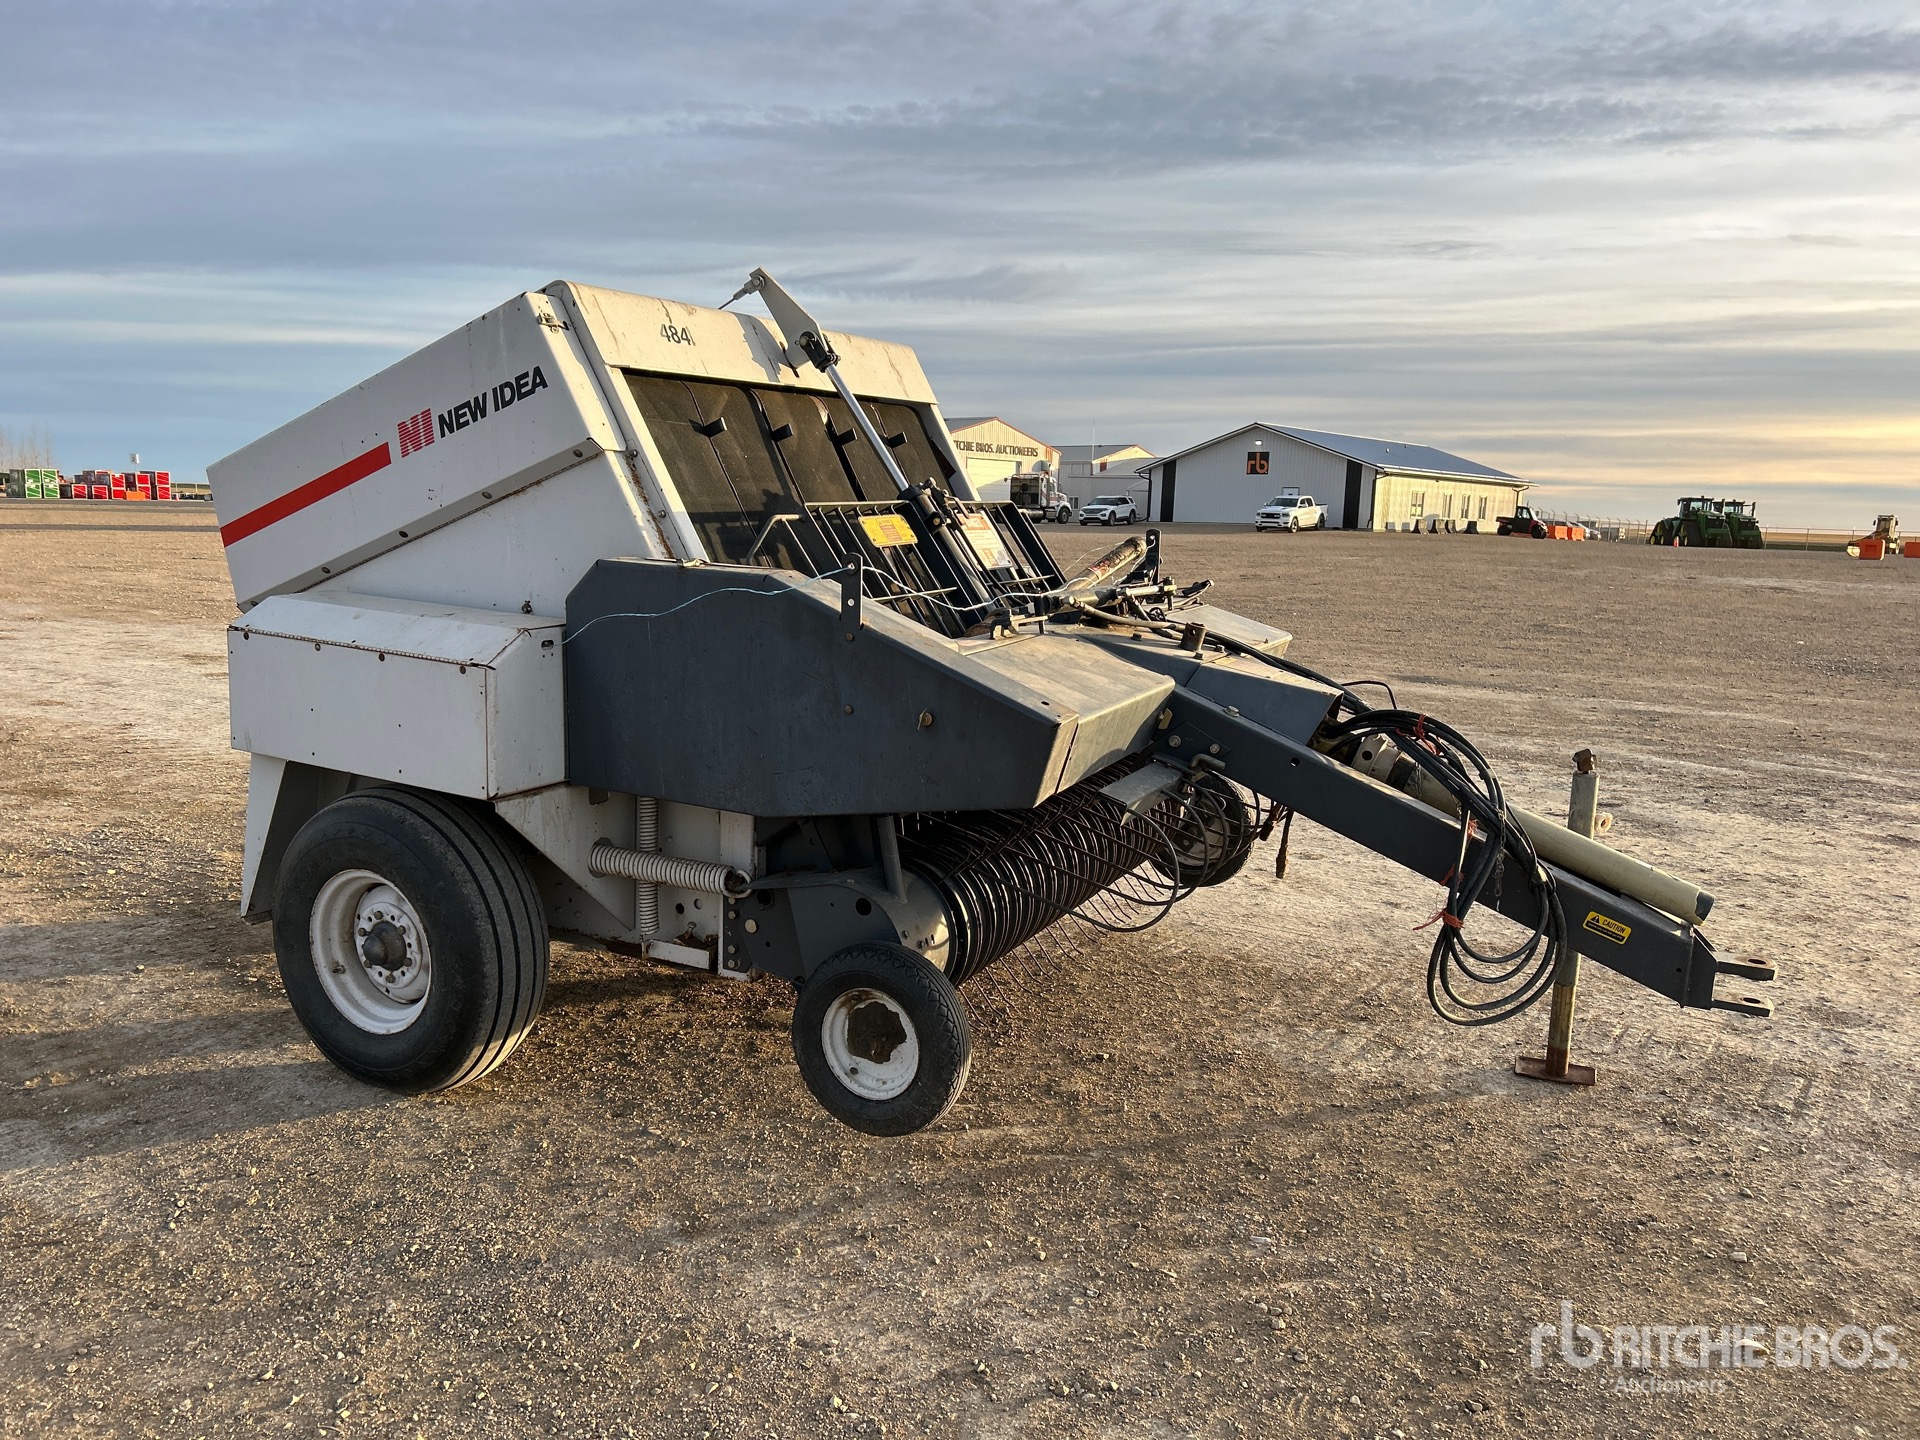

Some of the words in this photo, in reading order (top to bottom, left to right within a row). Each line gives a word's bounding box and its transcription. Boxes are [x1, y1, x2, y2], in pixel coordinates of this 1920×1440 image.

[660, 324, 691, 346] 484
[437, 391, 488, 439] NEW
[492, 365, 549, 412] IDEA
[976, 442, 994, 453] BROS.
[995, 444, 1039, 457] AUCTIONEERS
[1247, 452, 1268, 474] rb
[1602, 919, 1626, 934] CAUTION
